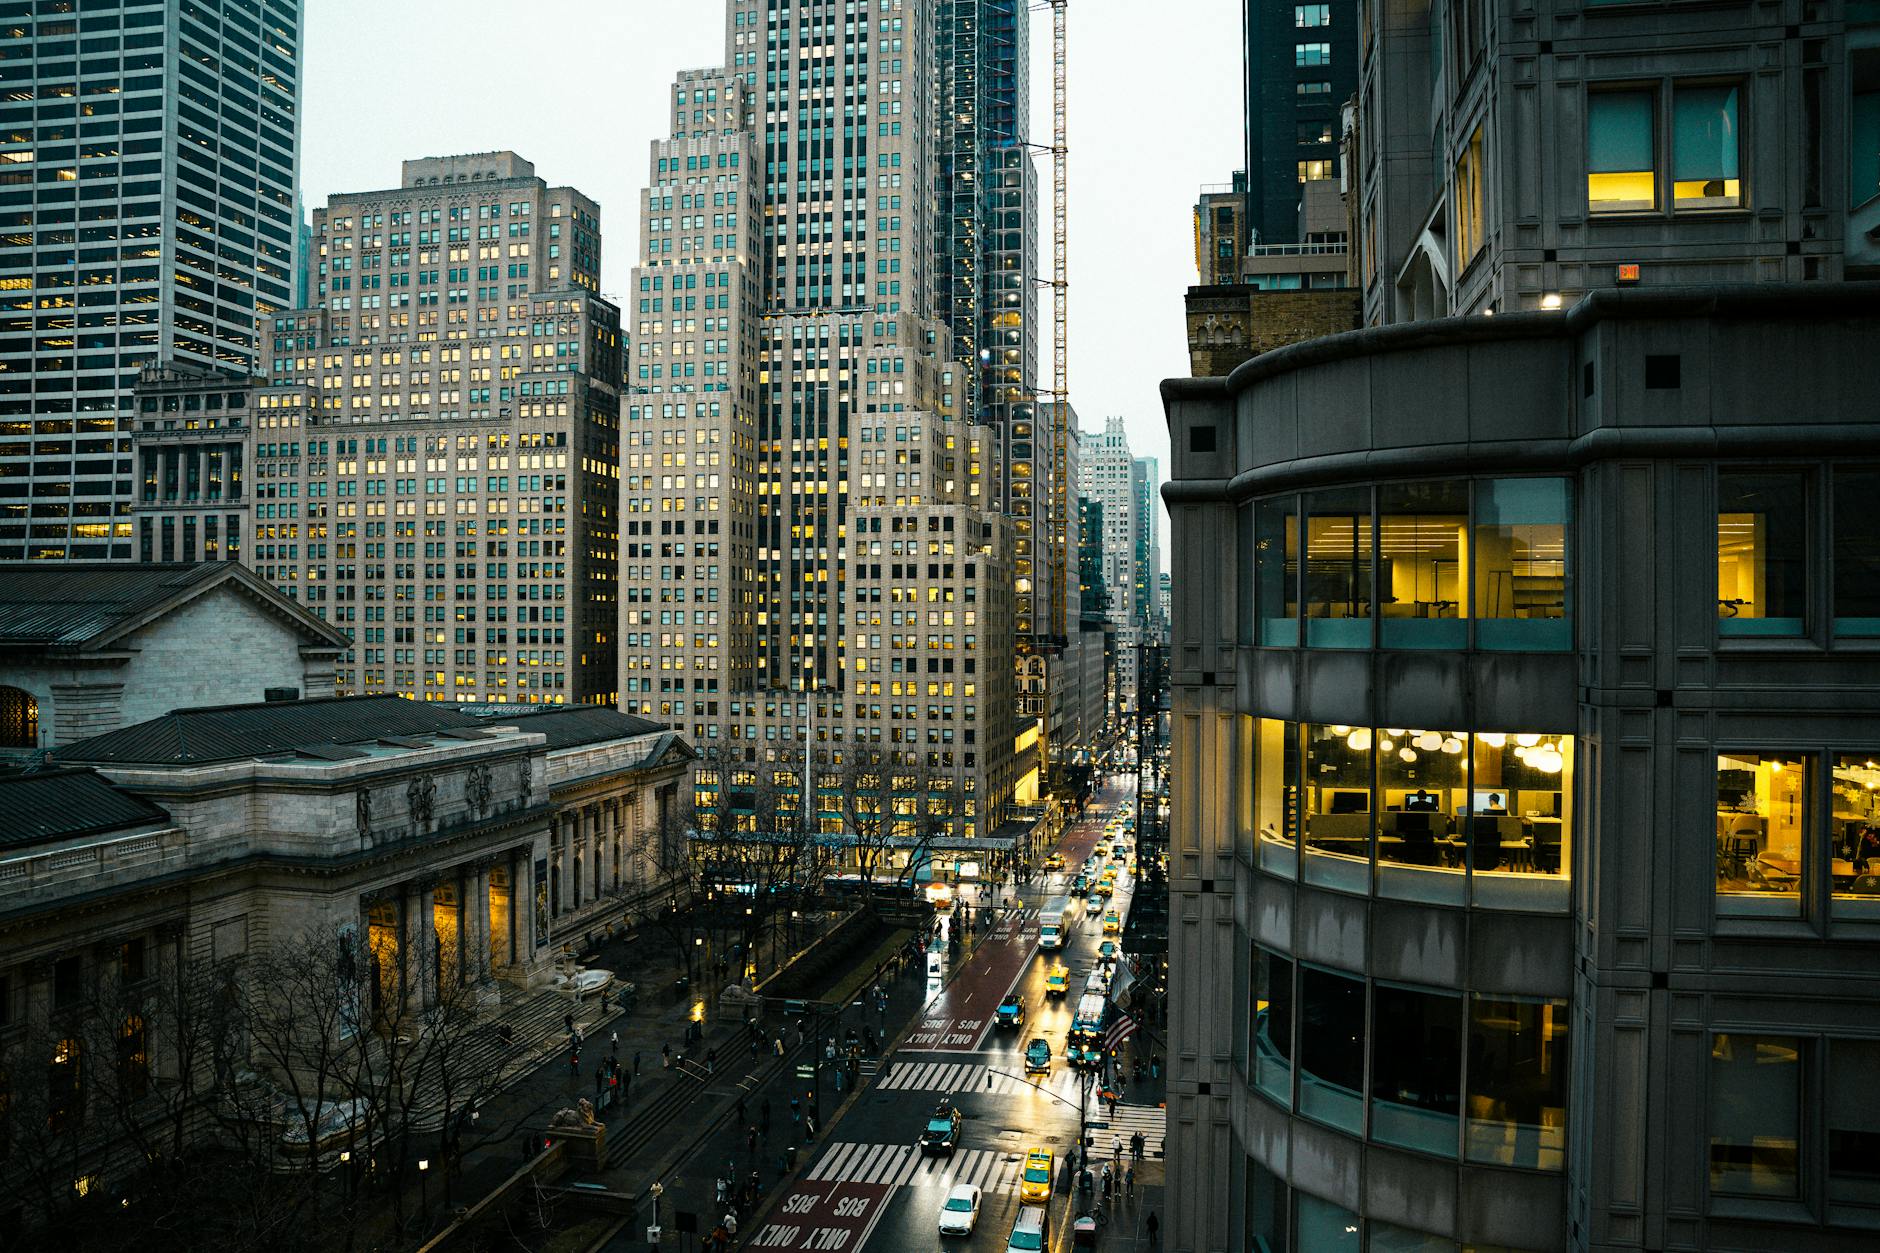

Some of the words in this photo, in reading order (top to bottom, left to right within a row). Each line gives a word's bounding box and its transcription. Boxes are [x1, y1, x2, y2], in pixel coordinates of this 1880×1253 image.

[921, 1019, 945, 1029] BUS
[958, 1020, 982, 1030] BUS
[905, 1033, 937, 1044] ONLY
[941, 1033, 973, 1045] ONLY
[782, 1193, 820, 1214] BUS
[833, 1197, 871, 1218] BUS
[750, 1224, 801, 1247] ONLY
[800, 1227, 852, 1250] ONLY
